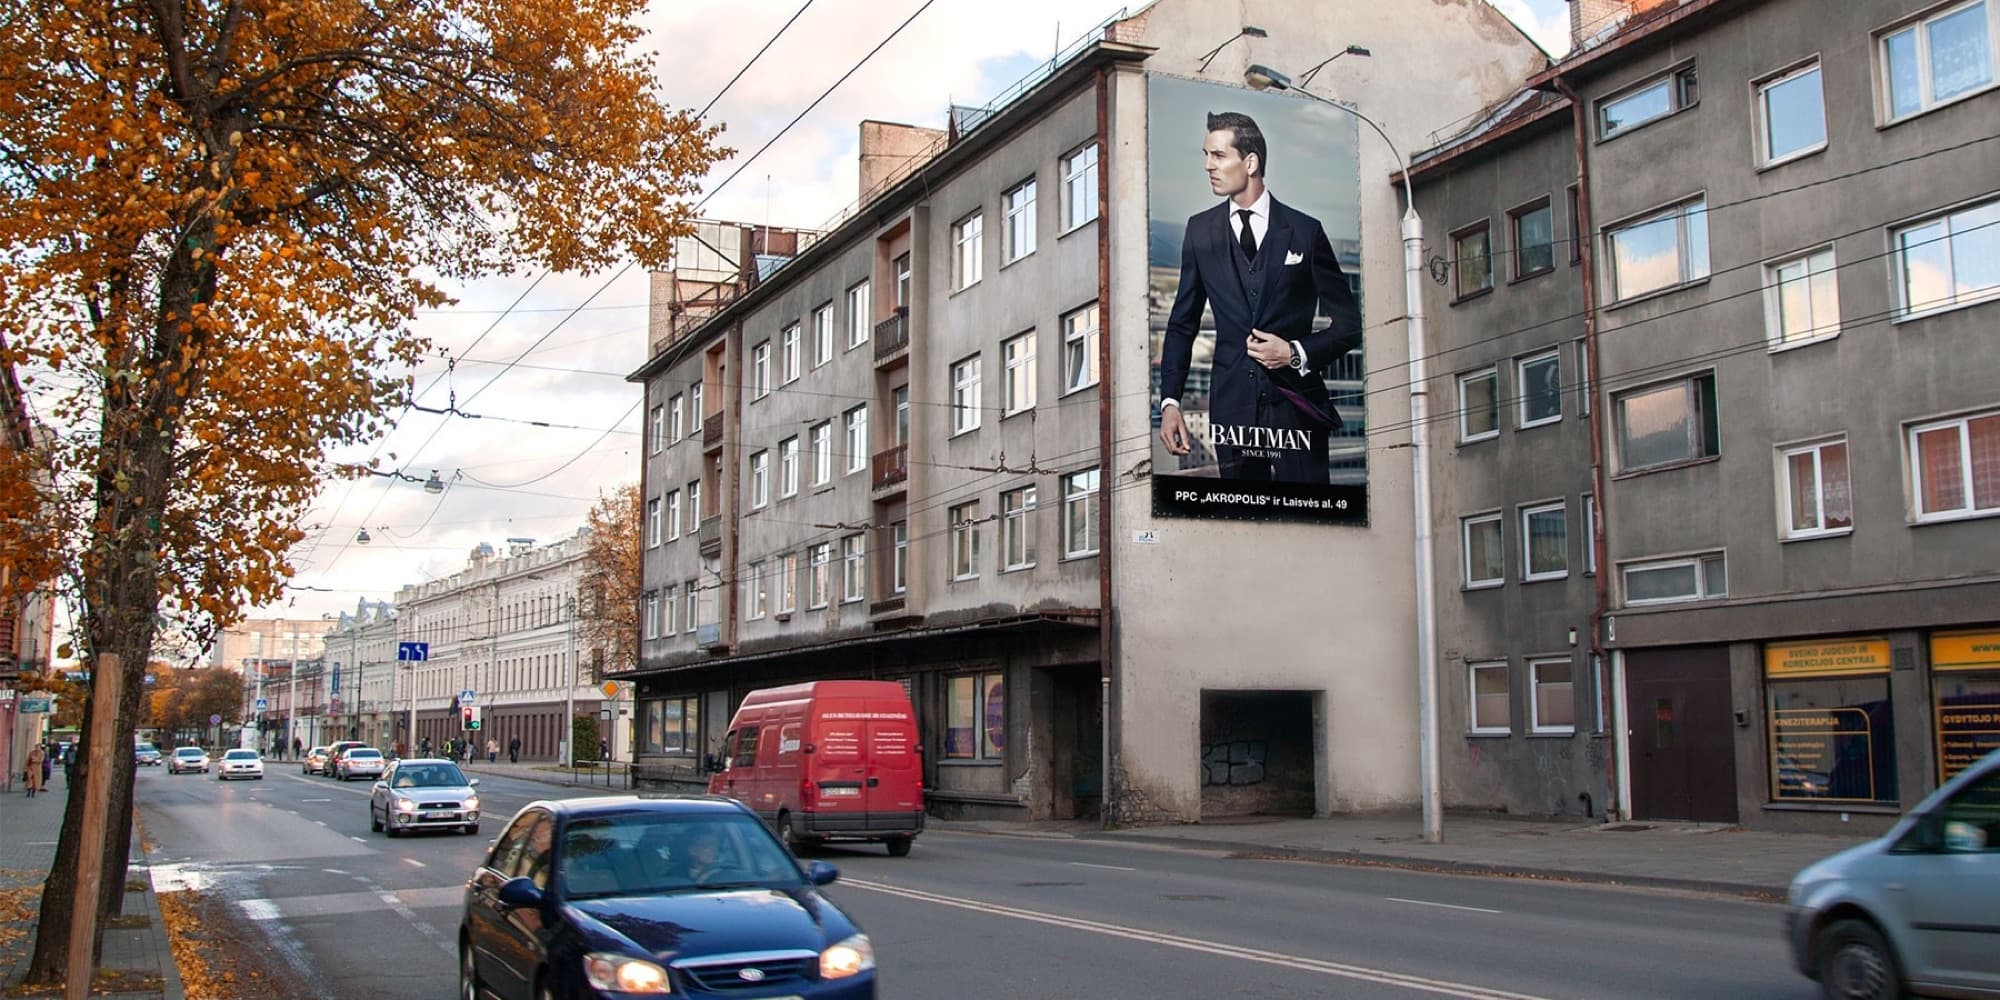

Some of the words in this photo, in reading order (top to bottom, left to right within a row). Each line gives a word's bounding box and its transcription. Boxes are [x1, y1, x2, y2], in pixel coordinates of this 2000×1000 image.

[1210, 424, 1312, 451] BALTMAN
[1241, 449, 1265, 457] SINCE
[1175, 490, 1198, 501] PPC
[1273, 496, 1281, 505] ir
[1282, 497, 1319, 508] Laisvės
[1322, 499, 1333, 509] al.
[1335, 500, 1348, 510] 49
[1837, 655, 1876, 665] CENTRAS
[1775, 717, 1839, 726] KINEZITERAPIJA
[1943, 714, 1991, 723] GYDYTOJO
